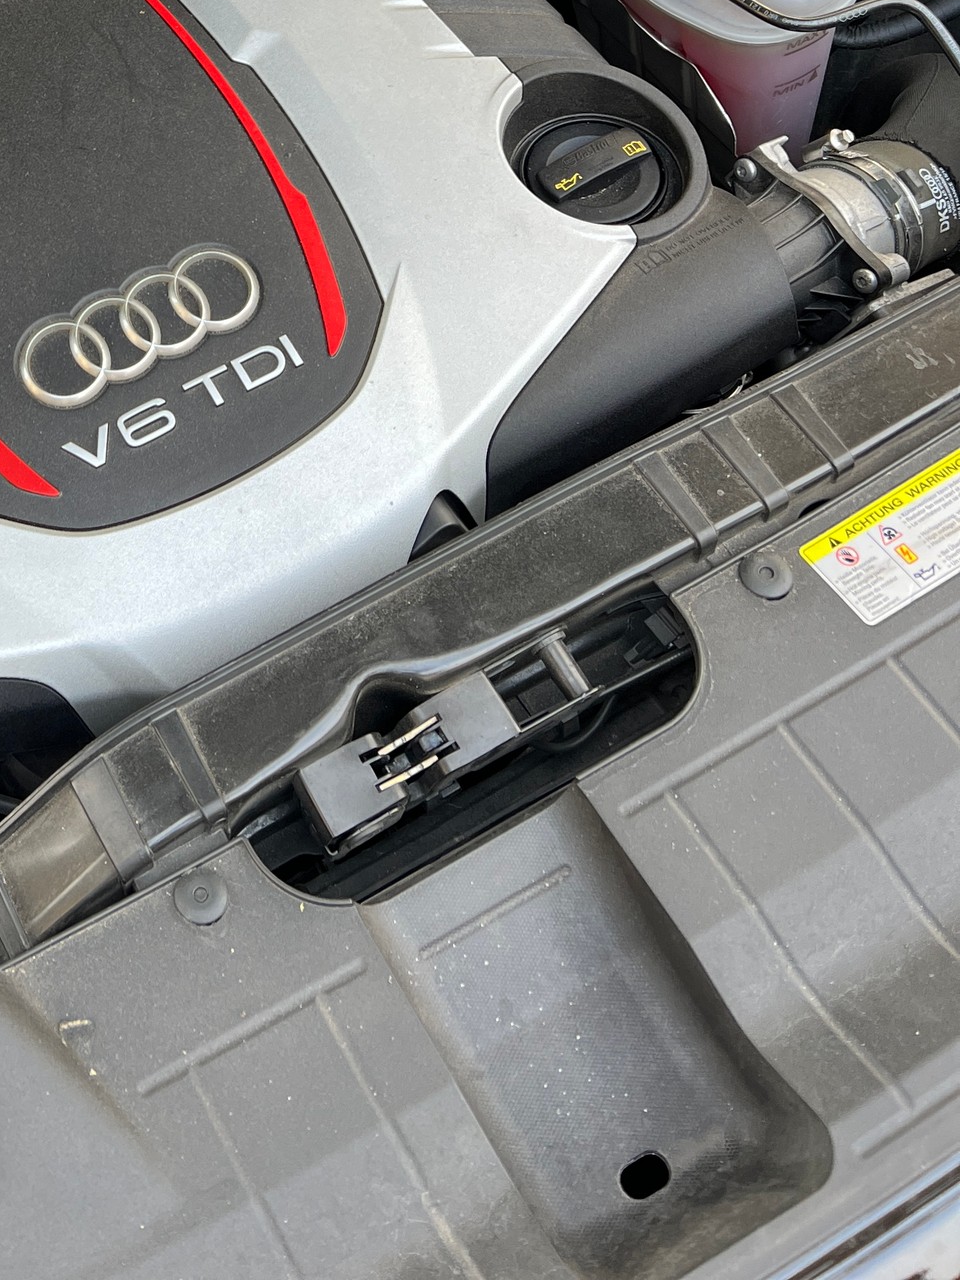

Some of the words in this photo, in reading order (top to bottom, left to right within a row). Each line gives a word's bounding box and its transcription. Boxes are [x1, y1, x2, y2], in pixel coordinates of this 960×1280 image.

[773, 80, 806, 97] MIN
[61, 398, 176, 468] V6
[182, 334, 303, 406] TDI
[845, 497, 903, 538] ACHTUNG
